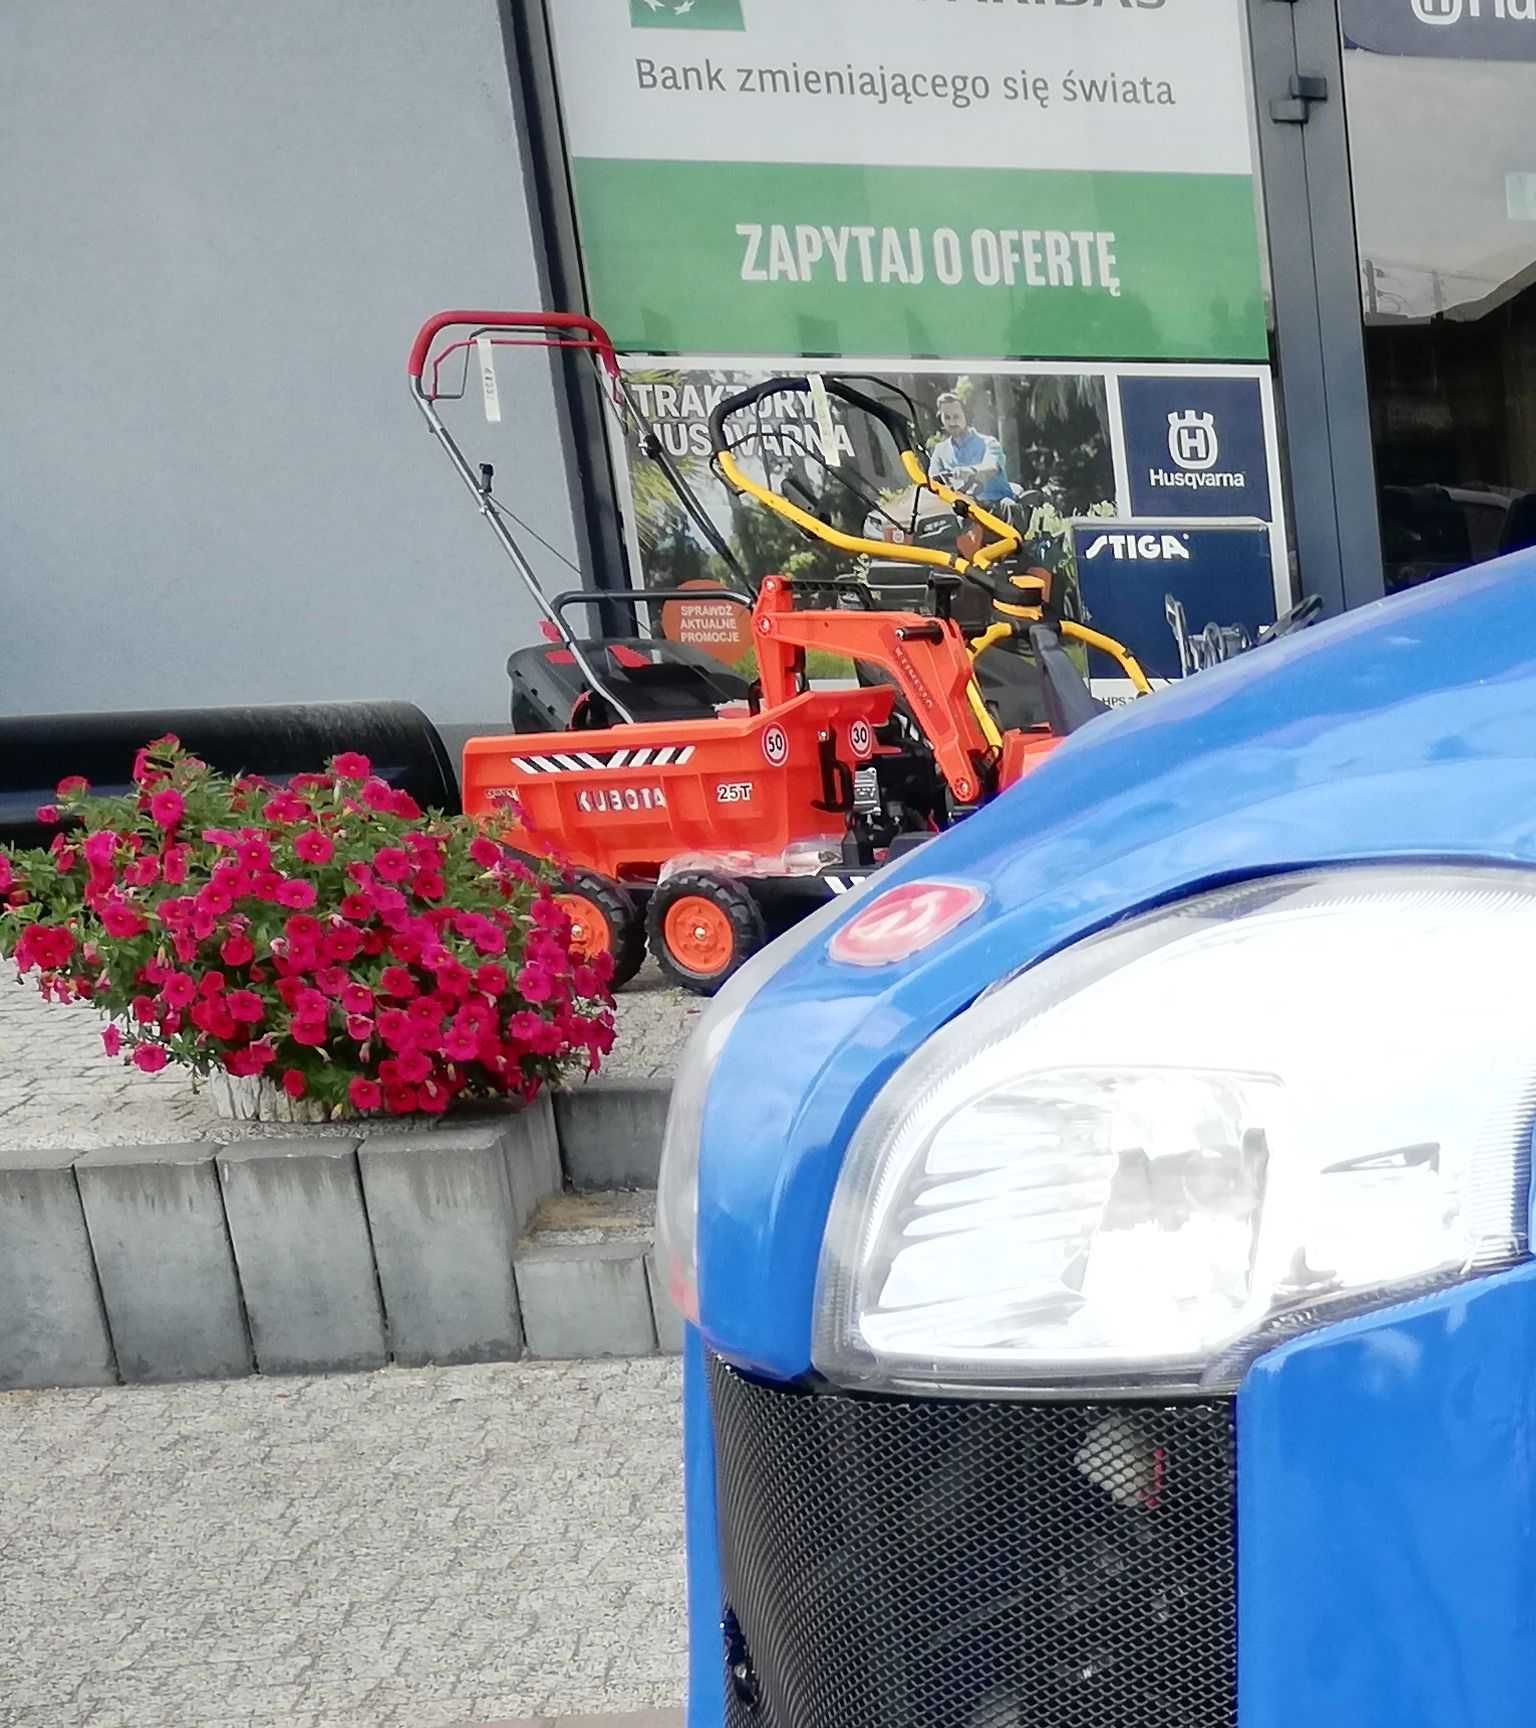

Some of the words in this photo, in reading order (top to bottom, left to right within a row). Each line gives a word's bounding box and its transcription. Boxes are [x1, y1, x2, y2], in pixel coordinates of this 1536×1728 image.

[634, 58, 726, 92] Bank
[735, 61, 991, 108] zmieniającego
[1004, 69, 1050, 108] się
[1062, 72, 1176, 106] świata
[736, 223, 925, 285] ZAPYTAJ
[933, 227, 963, 286] O
[971, 228, 1121, 297] OFERTĘ
[631, 384, 820, 418] TRAKORY
[1150, 469, 1246, 490] Husqvarna
[1085, 534, 1190, 560] STIGA
[680, 617, 738, 630] AKTUALNE
[680, 631, 741, 643] PROMOCJE
[768, 733, 784, 753] 50
[853, 725, 868, 744] 30
[576, 787, 668, 813] KUBOTA
[718, 784, 752, 801] 25T
